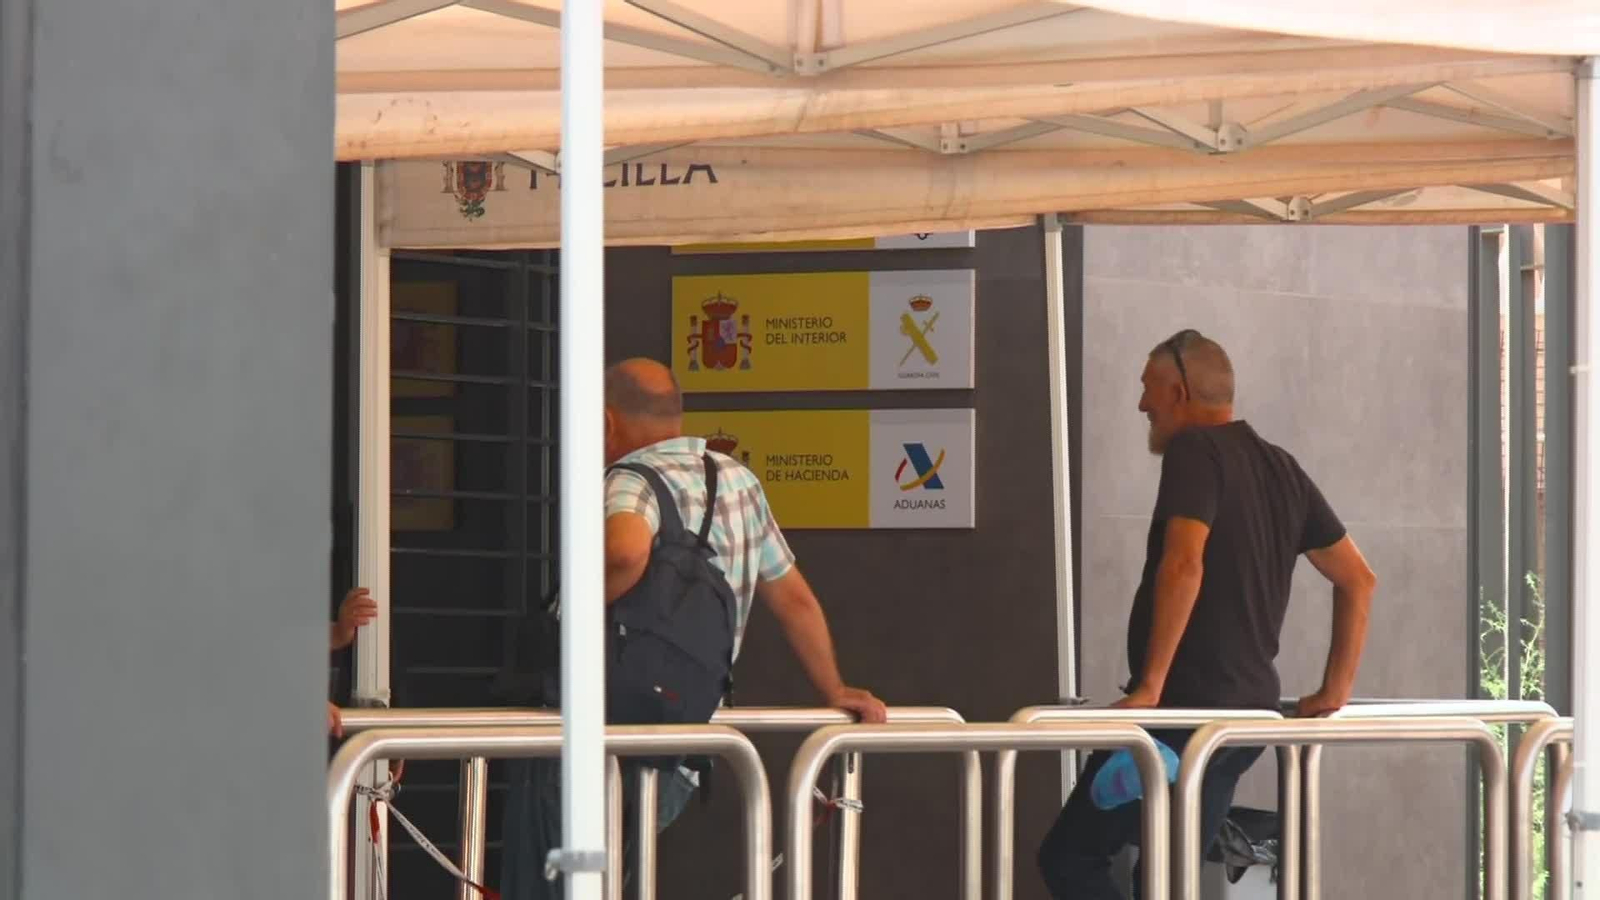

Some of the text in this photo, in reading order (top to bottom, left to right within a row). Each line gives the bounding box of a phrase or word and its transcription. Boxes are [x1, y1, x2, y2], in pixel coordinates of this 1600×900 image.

[765, 316, 833, 330] MINISTERIO
[765, 331, 847, 345] DEL INTERIOR
[765, 454, 834, 467] MINISTERIO
[765, 468, 850, 482] DE HACIENDA
[893, 498, 946, 510] ADUANAS
